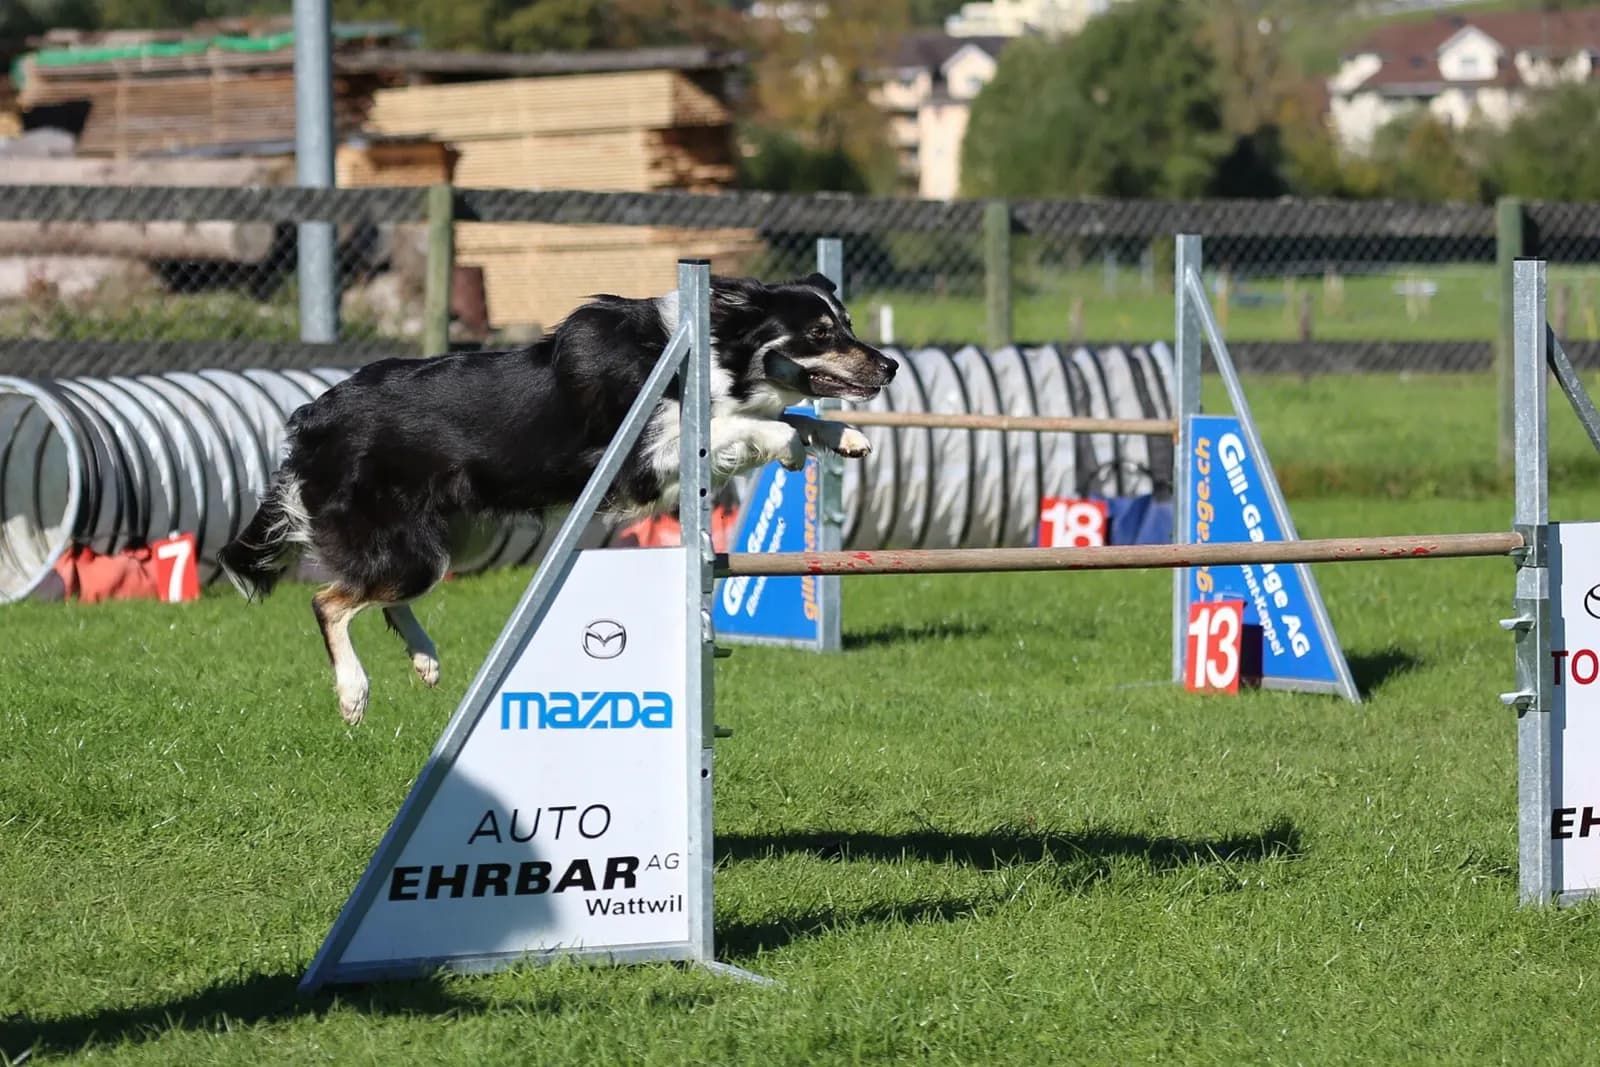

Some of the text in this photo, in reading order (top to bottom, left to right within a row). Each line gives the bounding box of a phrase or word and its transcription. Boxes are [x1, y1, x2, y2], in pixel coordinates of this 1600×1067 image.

[1041, 502, 1104, 547] 18
[157, 540, 191, 604] 7
[1188, 606, 1239, 688] 13
[1281, 614, 1311, 658] AG
[1551, 649, 1599, 685] TO
[468, 804, 611, 845] AUTO
[1551, 806, 1600, 840] EH
[388, 853, 680, 902] EHRBAR AG
[586, 895, 682, 917] Wattwil
